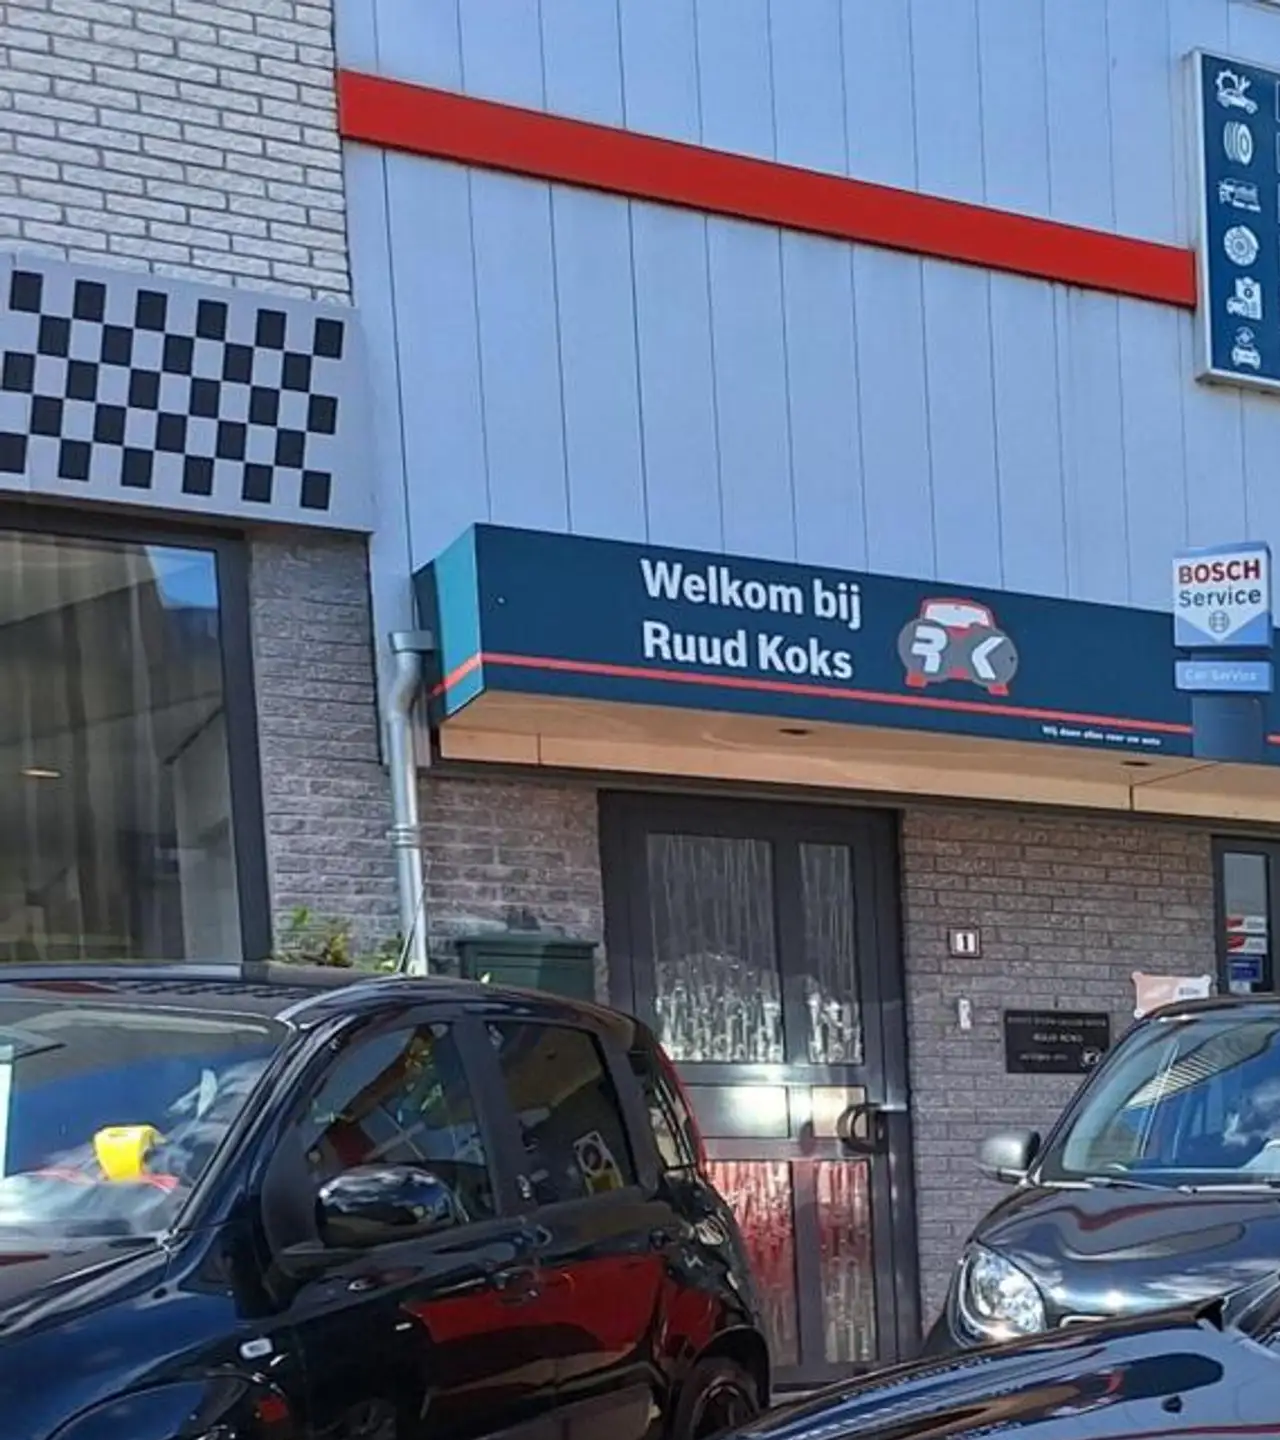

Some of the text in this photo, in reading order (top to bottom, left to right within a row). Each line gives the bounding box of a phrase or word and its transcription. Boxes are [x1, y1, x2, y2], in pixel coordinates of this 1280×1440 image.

[640, 558, 863, 630] Welkom bij
[1178, 558, 1261, 585] BOSCH
[1178, 585, 1262, 609] Service
[642, 619, 855, 682] Ruud Koks
